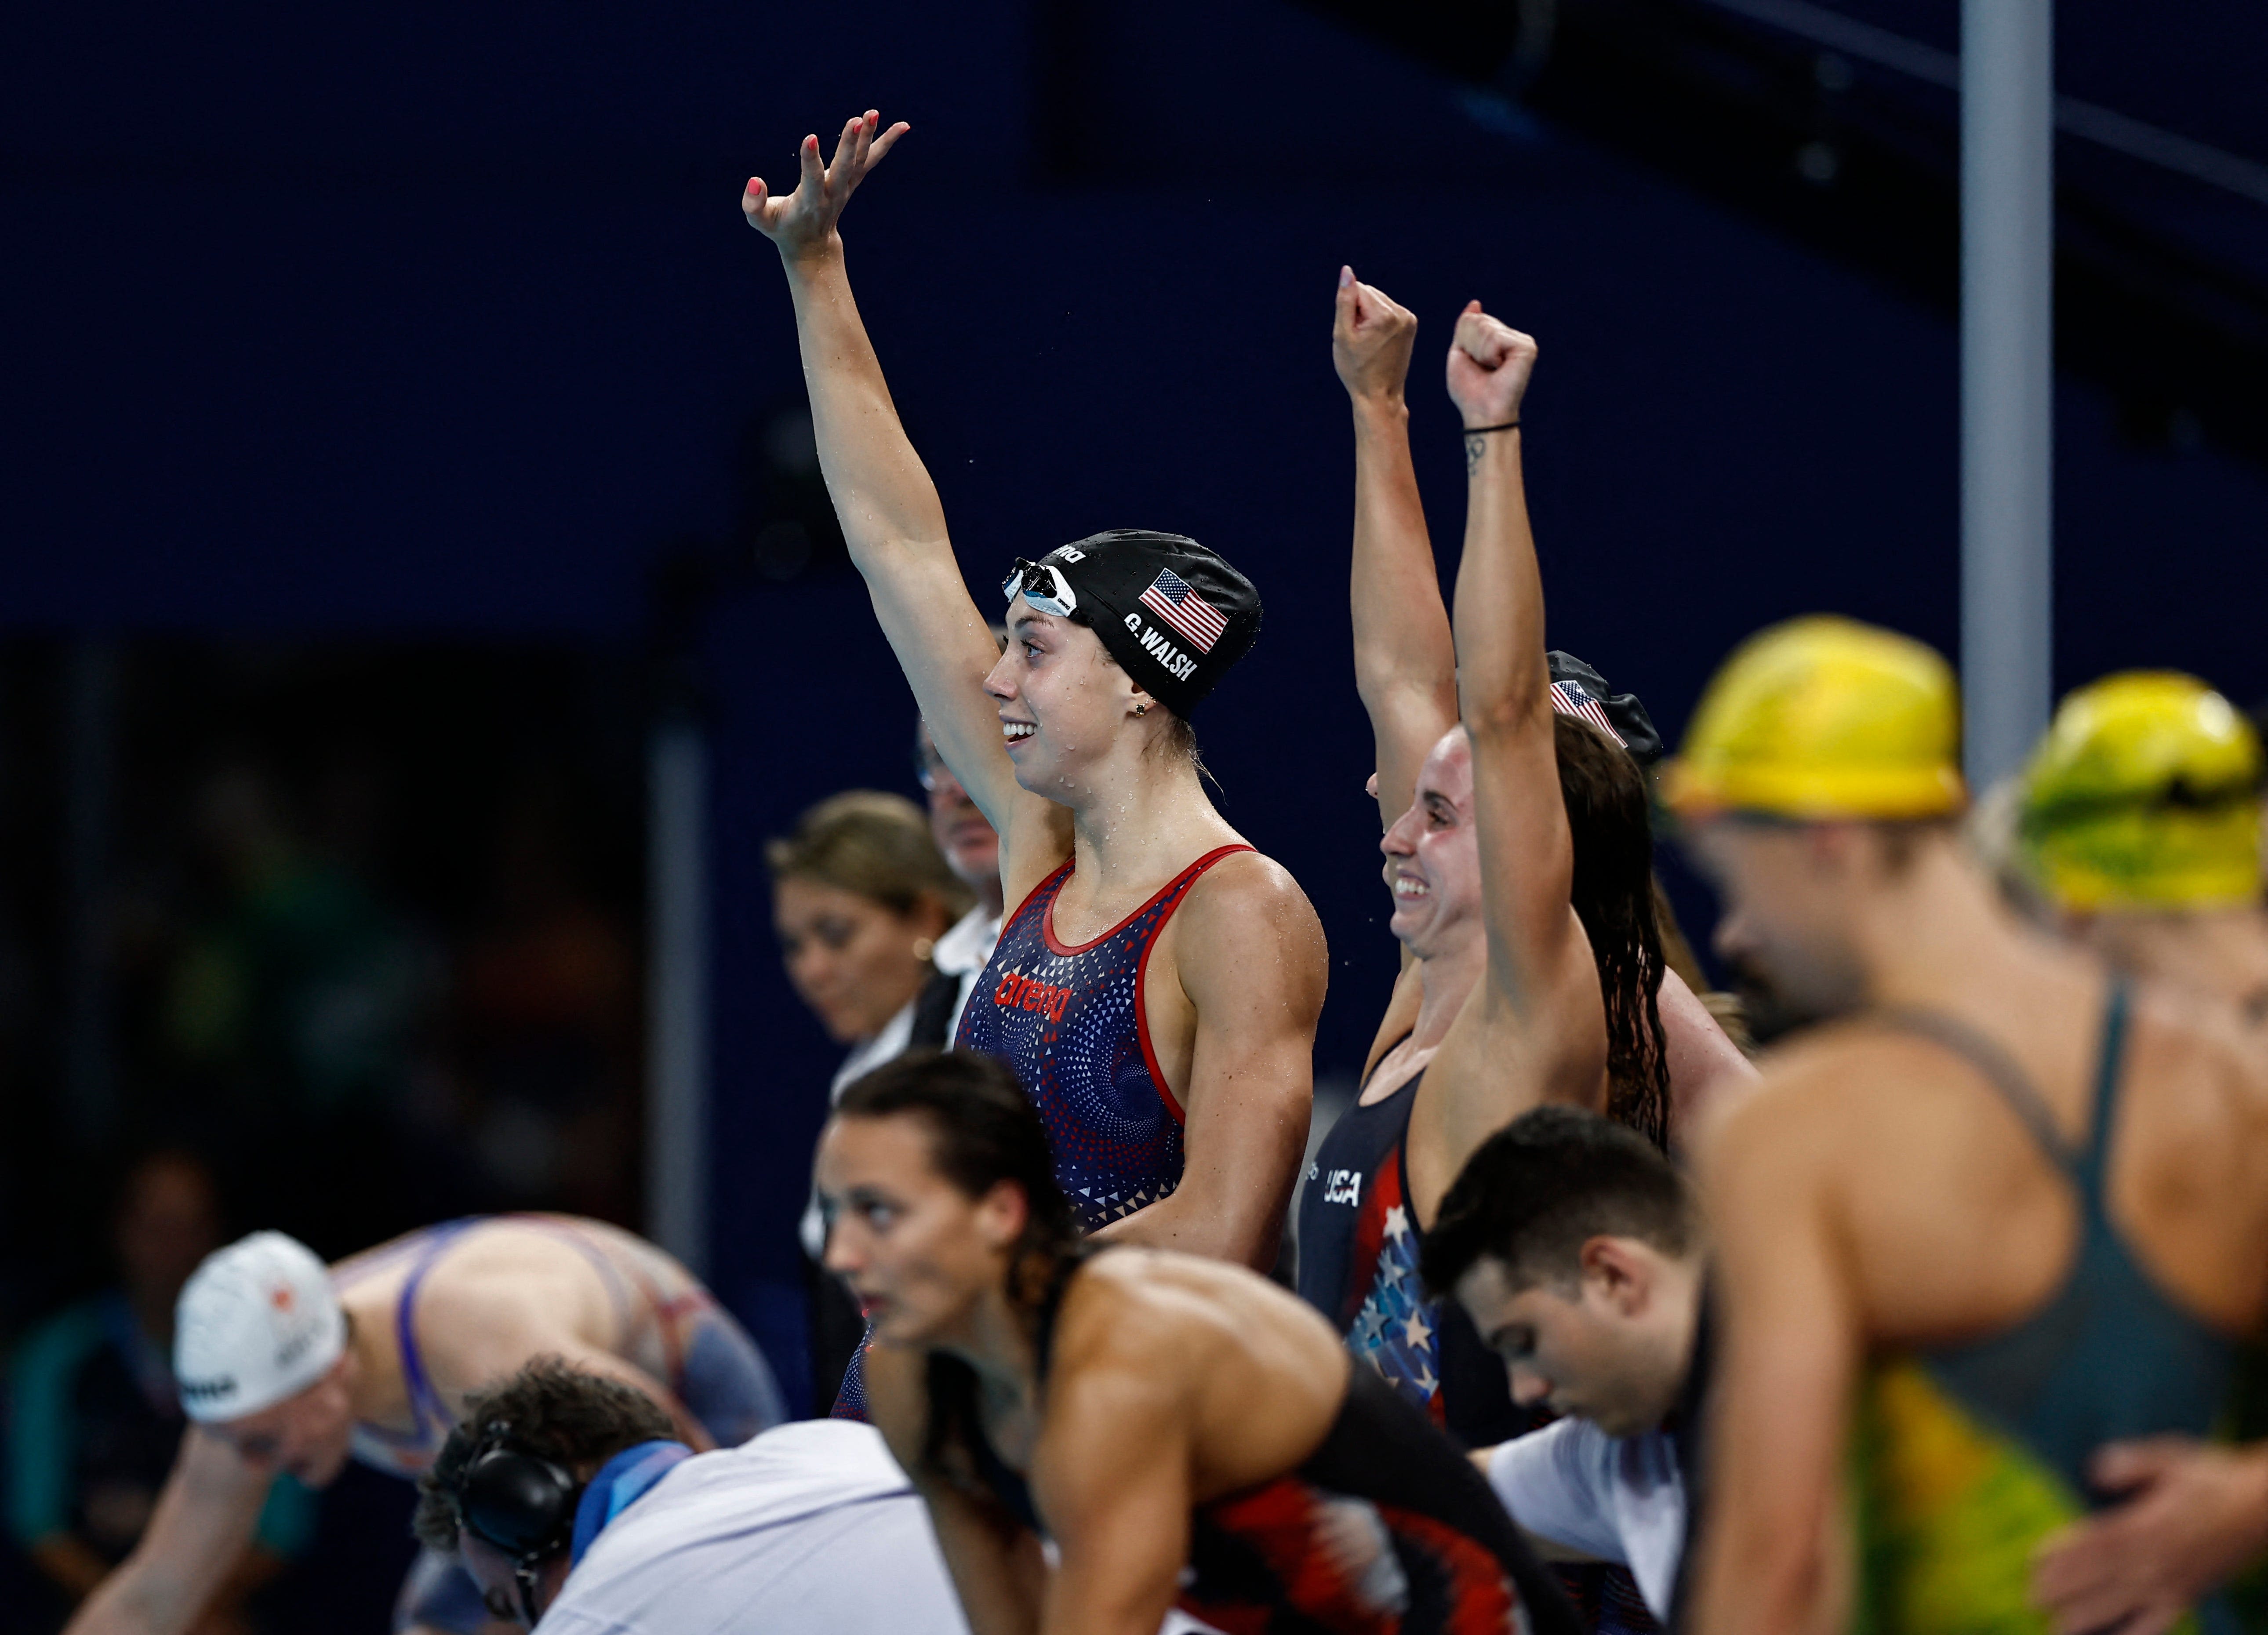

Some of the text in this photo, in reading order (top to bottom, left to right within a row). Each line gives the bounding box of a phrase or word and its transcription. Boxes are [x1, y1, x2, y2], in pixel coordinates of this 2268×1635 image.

[1058, 598, 1071, 610] arena
[994, 973, 1073, 1023] arena
[1324, 1170, 1362, 1207] USA
